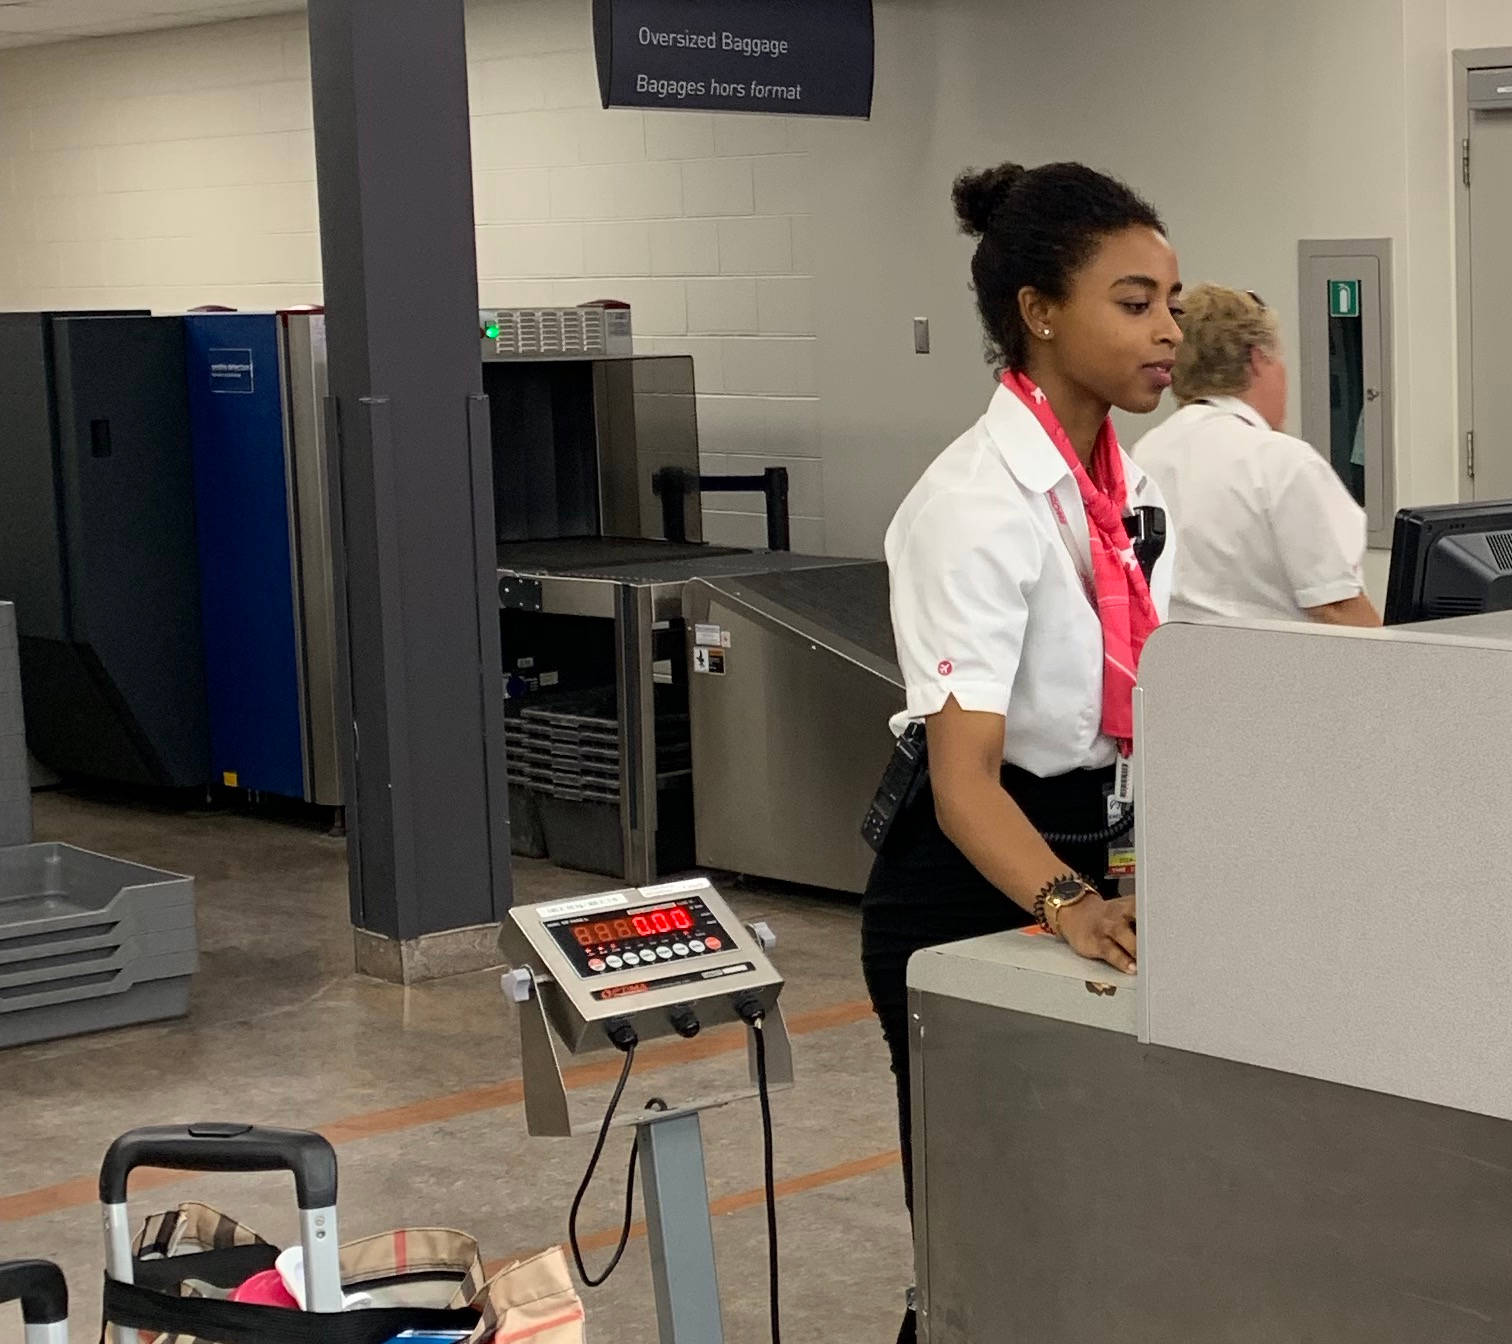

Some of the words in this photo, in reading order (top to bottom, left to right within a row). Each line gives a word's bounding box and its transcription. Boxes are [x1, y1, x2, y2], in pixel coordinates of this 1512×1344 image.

[638, 26, 716, 50] Oversized
[721, 32, 788, 58] Baggage
[636, 74, 705, 100] Bagages
[710, 79, 745, 97] hors
[750, 80, 801, 100] format
